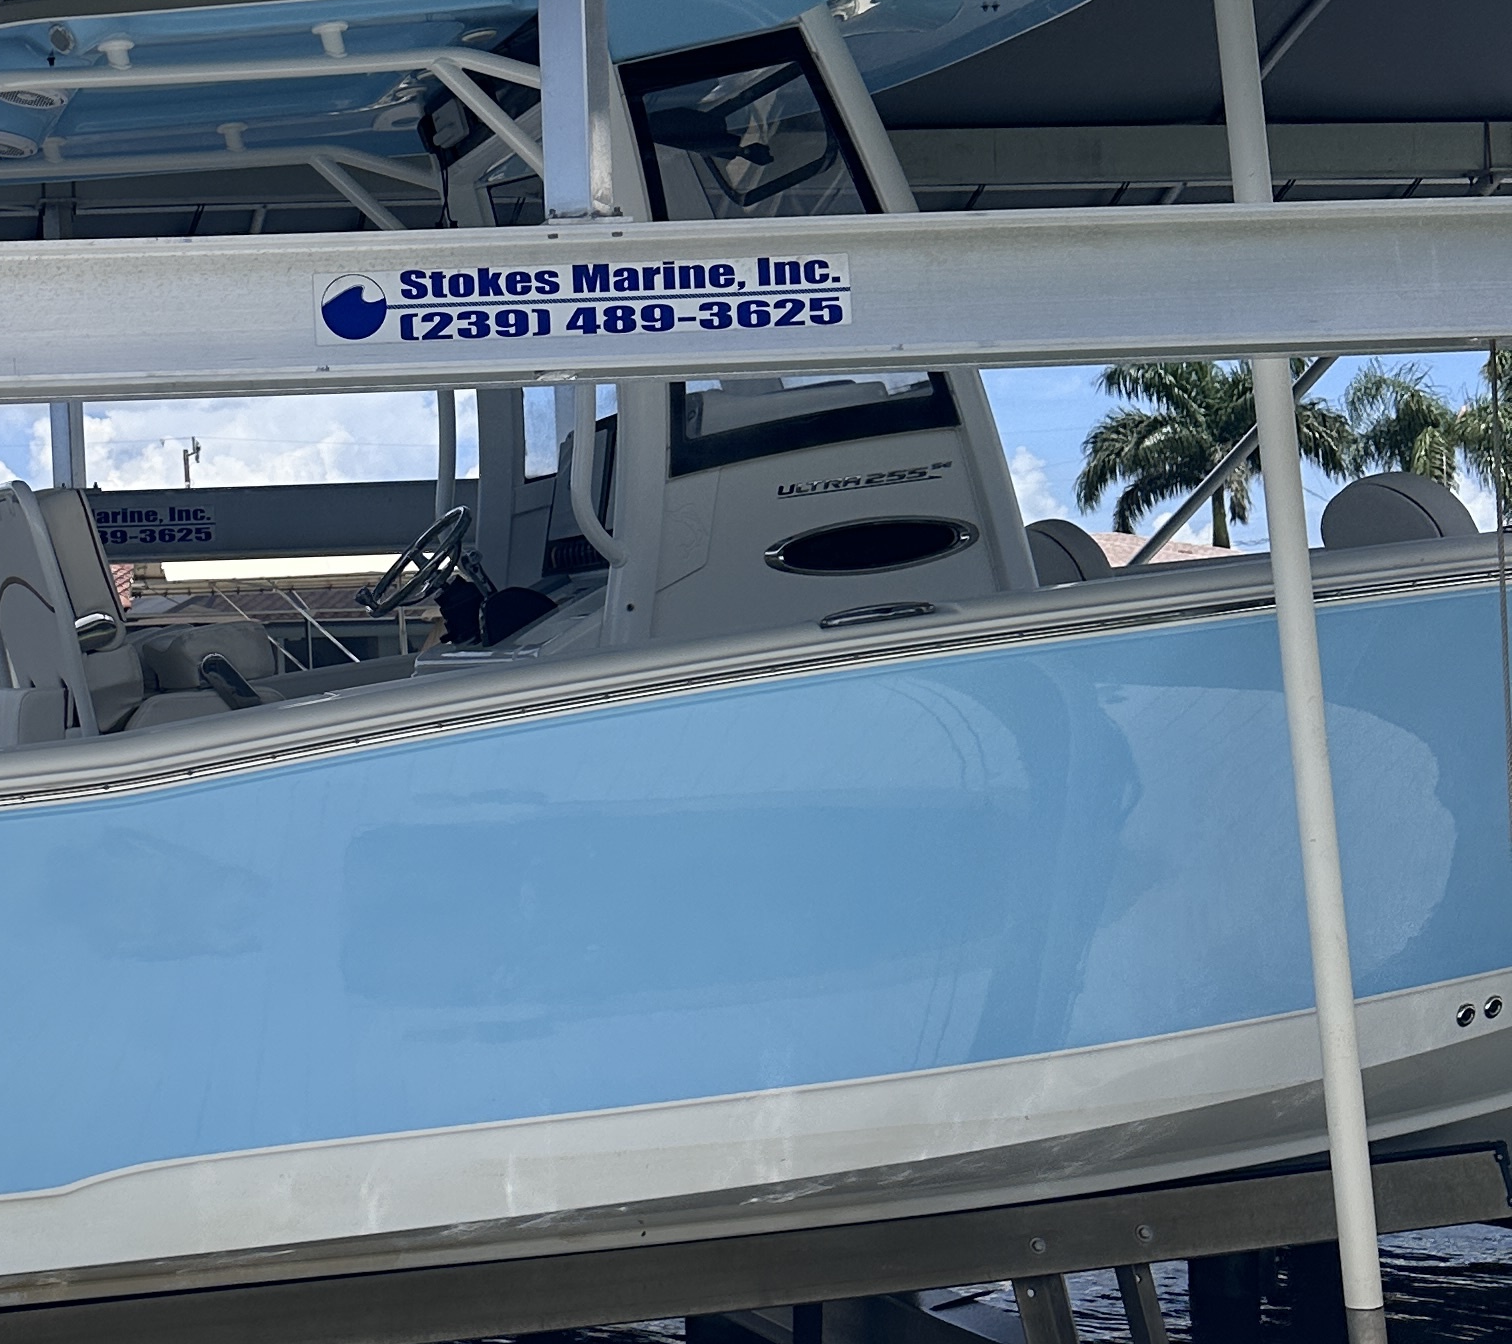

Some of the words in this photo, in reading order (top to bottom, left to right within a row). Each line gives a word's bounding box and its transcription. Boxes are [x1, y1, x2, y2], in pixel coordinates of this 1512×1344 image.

[400, 267, 560, 300] Stokes
[572, 260, 745, 293] Marine,
[757, 256, 841, 287] Inc.
[400, 307, 551, 341] (239)
[565, 296, 844, 335] 489-3625
[777, 475, 861, 496] ULTRA
[865, 467, 928, 484] 255
[92, 507, 164, 524] arine,
[169, 506, 211, 522] Inc.
[98, 527, 213, 545] 9-3625
